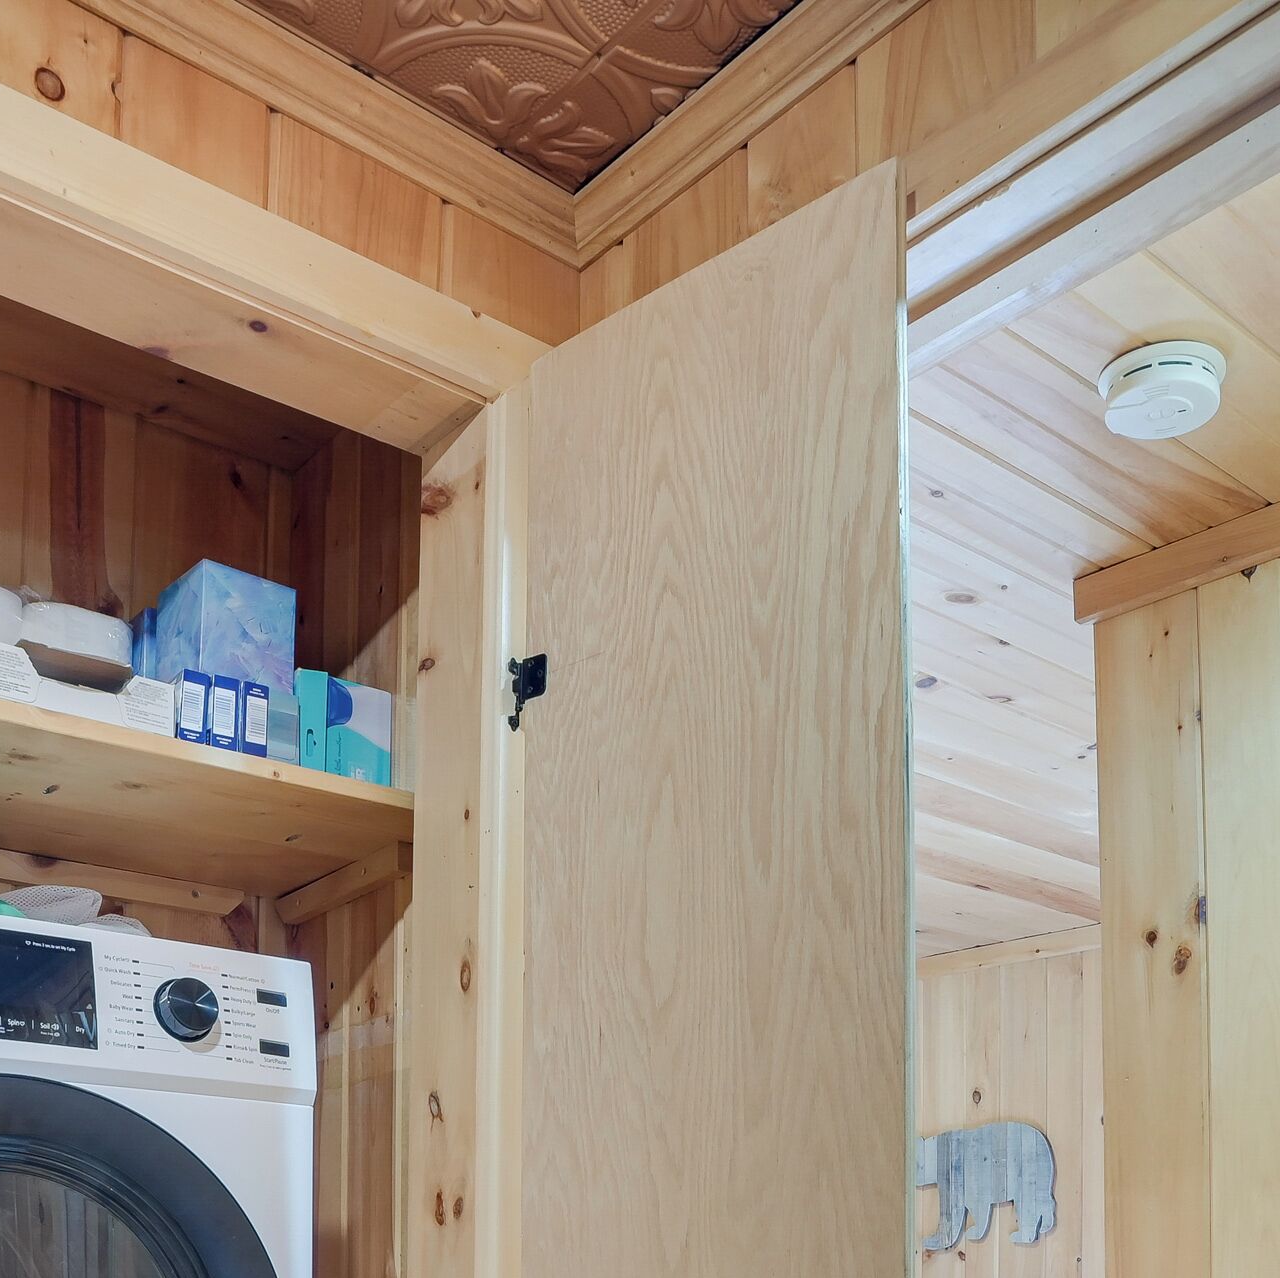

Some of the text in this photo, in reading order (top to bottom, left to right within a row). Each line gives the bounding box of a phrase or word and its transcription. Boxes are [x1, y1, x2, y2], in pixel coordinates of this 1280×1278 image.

[8, 1018, 20, 1026] Spin
[40, 1022, 50, 1030] Soil
[75, 1026, 85, 1034] Dry
